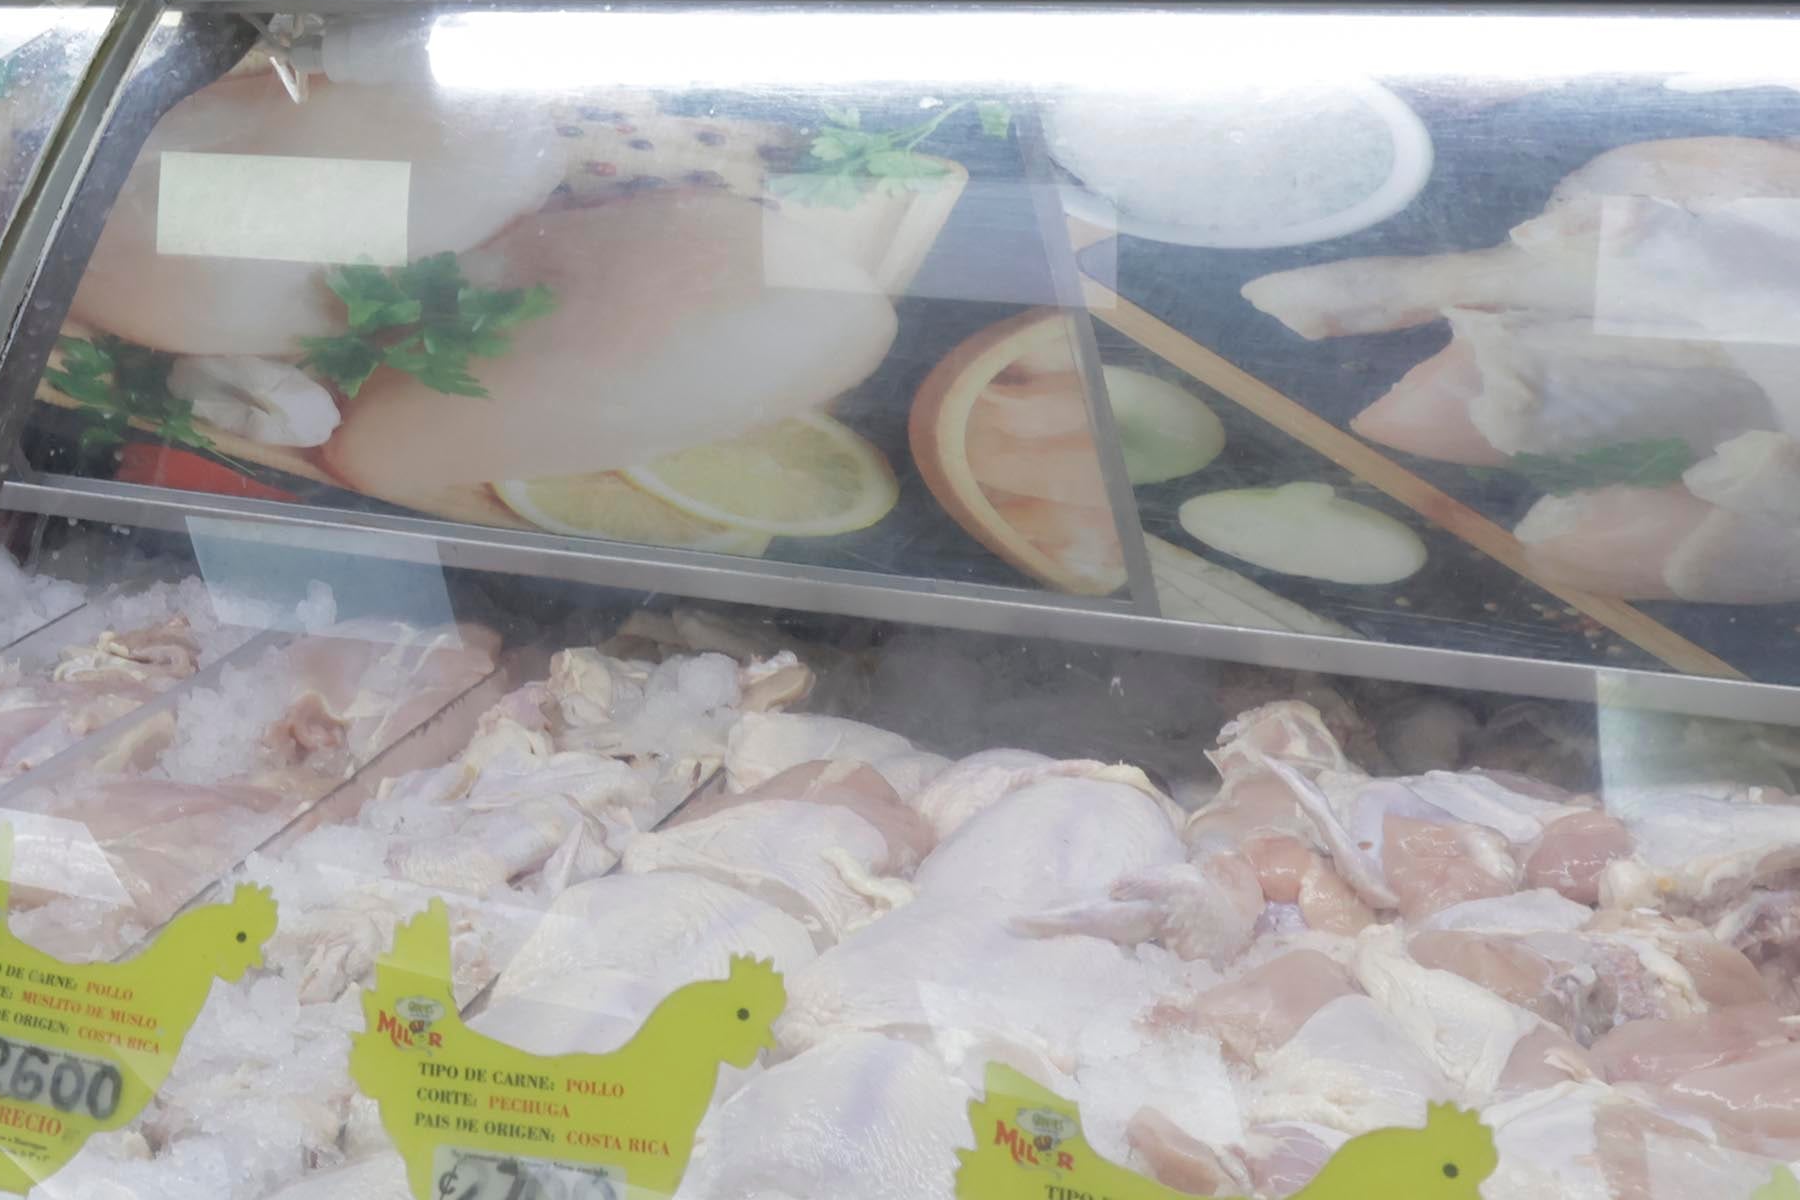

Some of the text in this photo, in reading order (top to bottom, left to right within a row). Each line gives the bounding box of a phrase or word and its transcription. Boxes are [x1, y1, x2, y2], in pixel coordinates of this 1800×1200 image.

[6, 963, 24, 978] DE
[28, 968, 78, 990] CARNE:
[86, 981, 134, 1002] POLLO
[21, 989, 82, 1015] MUSLITO
[85, 1003, 105, 1019] DE
[108, 1009, 159, 1031] MUSLO
[13, 1011, 71, 1036] ORIGEN:
[77, 1025, 122, 1047] COSTA
[125, 1035, 161, 1055] RICA
[419, 1061, 625, 1098] TIPO DE CARNE: POLLO
[416, 1087, 570, 1119] CORTE: PECHUGA
[414, 1111, 670, 1158] PAIS DE ORIGEN: COSTA RICA
[1044, 1183, 1094, 1200] TIPO
